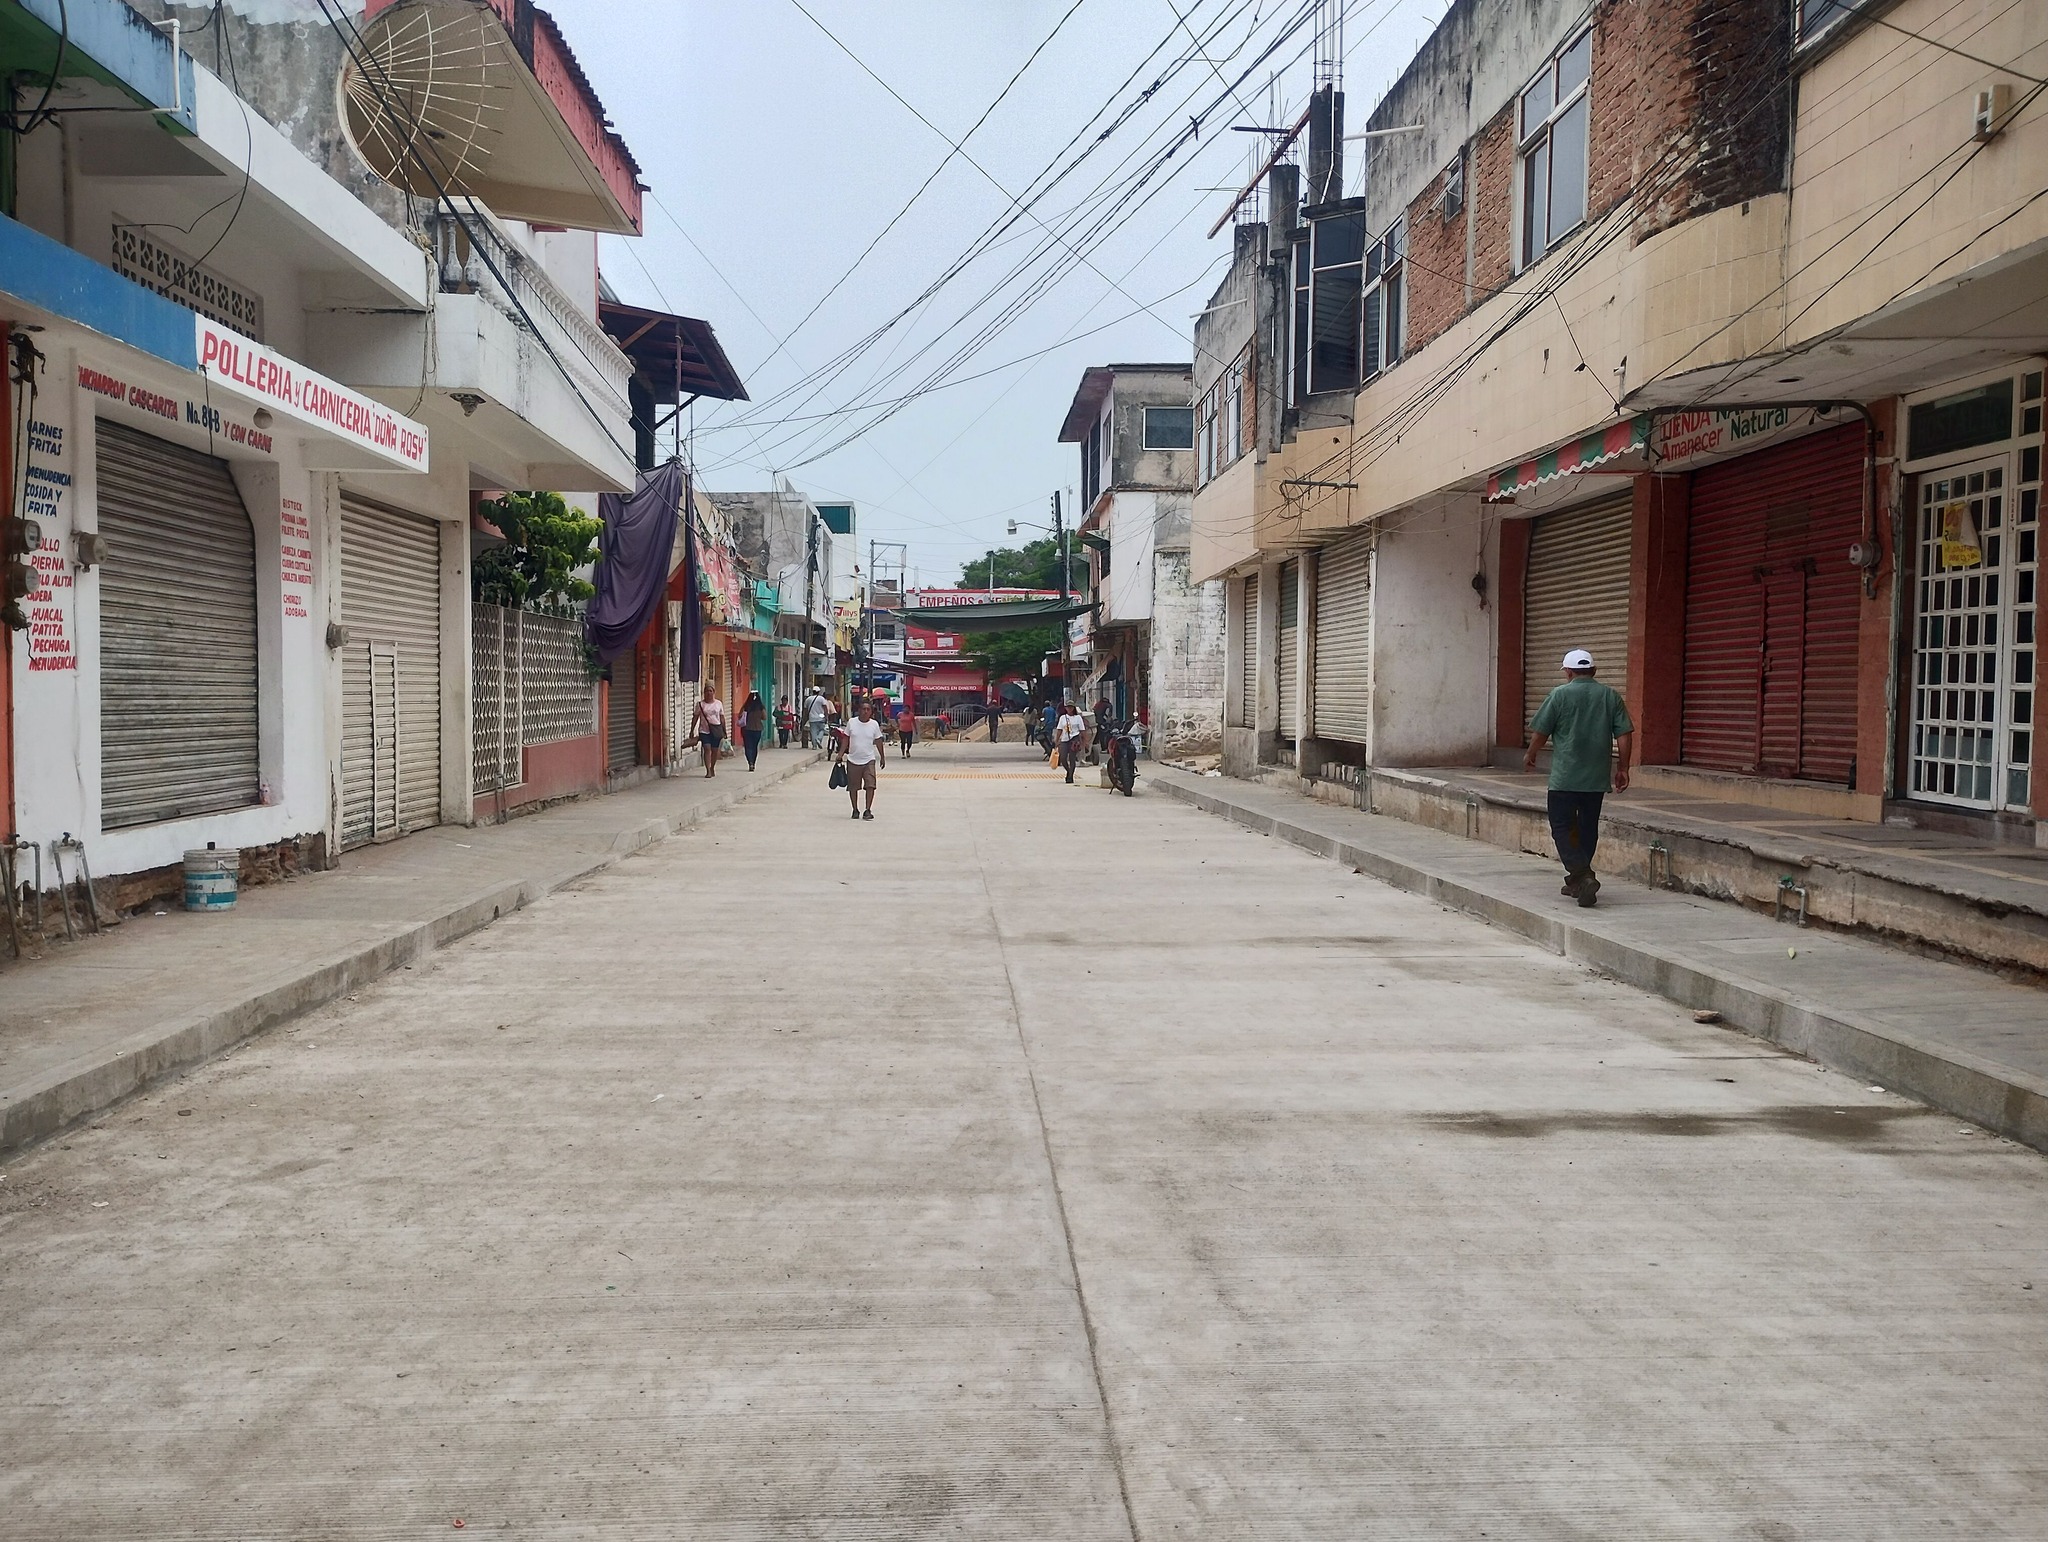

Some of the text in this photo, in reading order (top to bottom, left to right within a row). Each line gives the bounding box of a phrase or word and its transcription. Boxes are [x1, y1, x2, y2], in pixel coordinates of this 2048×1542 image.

[202, 330, 292, 403] POLLERIA
[303, 380, 371, 440] CARNICERIA
[129, 386, 178, 421] CASCARITA
[224, 420, 230, 438] Y
[230, 423, 247, 444] CON
[248, 429, 273, 454] CARNE
[1660, 411, 1711, 440] TIENDA
[1662, 428, 1723, 462] Amanecer
[1731, 407, 1789, 441] Natural
[29, 437, 62, 456] FRITAS
[26, 465, 71, 487] MENUDENCIA
[56, 489, 63, 502] Y
[28, 500, 57, 517] FRITA
[31, 555, 65, 571] PIERNA
[52, 574, 73, 588] ALITA
[919, 595, 975, 607] EMPEÑOS
[32, 608, 64, 622] HUACAL
[32, 623, 63, 636] PATITA
[33, 638, 70, 653] PECHUGA
[29, 656, 76, 671] MENUDENCIA
